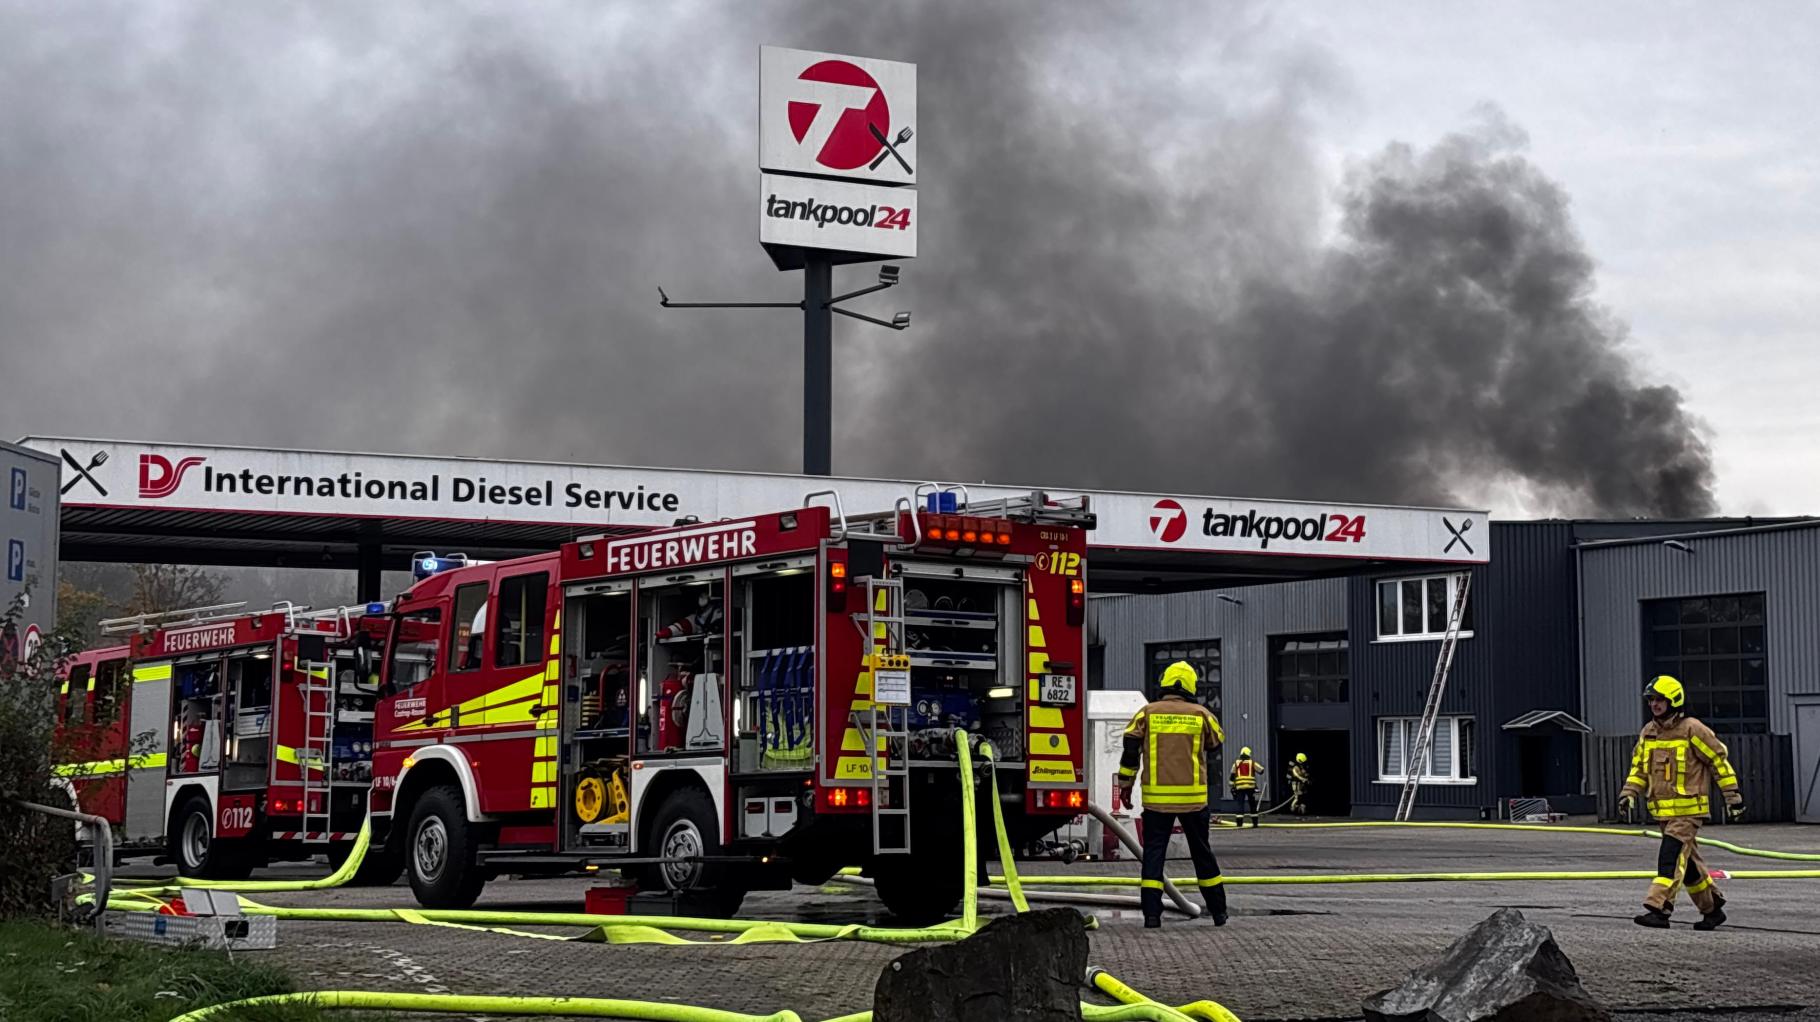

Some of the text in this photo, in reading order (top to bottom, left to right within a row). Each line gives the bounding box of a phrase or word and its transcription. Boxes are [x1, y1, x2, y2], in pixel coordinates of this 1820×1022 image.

[766, 193, 911, 231] tankpool24
[203, 466, 679, 512] International Diesel Service
[1202, 507, 1366, 549] tankpool24
[607, 520, 757, 573] FEUERWEHR
[1050, 551, 1080, 576] 112
[163, 621, 236, 653] FEUERWEHR
[1047, 689, 1069, 701] 6822
[1051, 676, 1064, 688] RE
[846, 764, 857, 774] LF
[231, 806, 253, 829] 112
